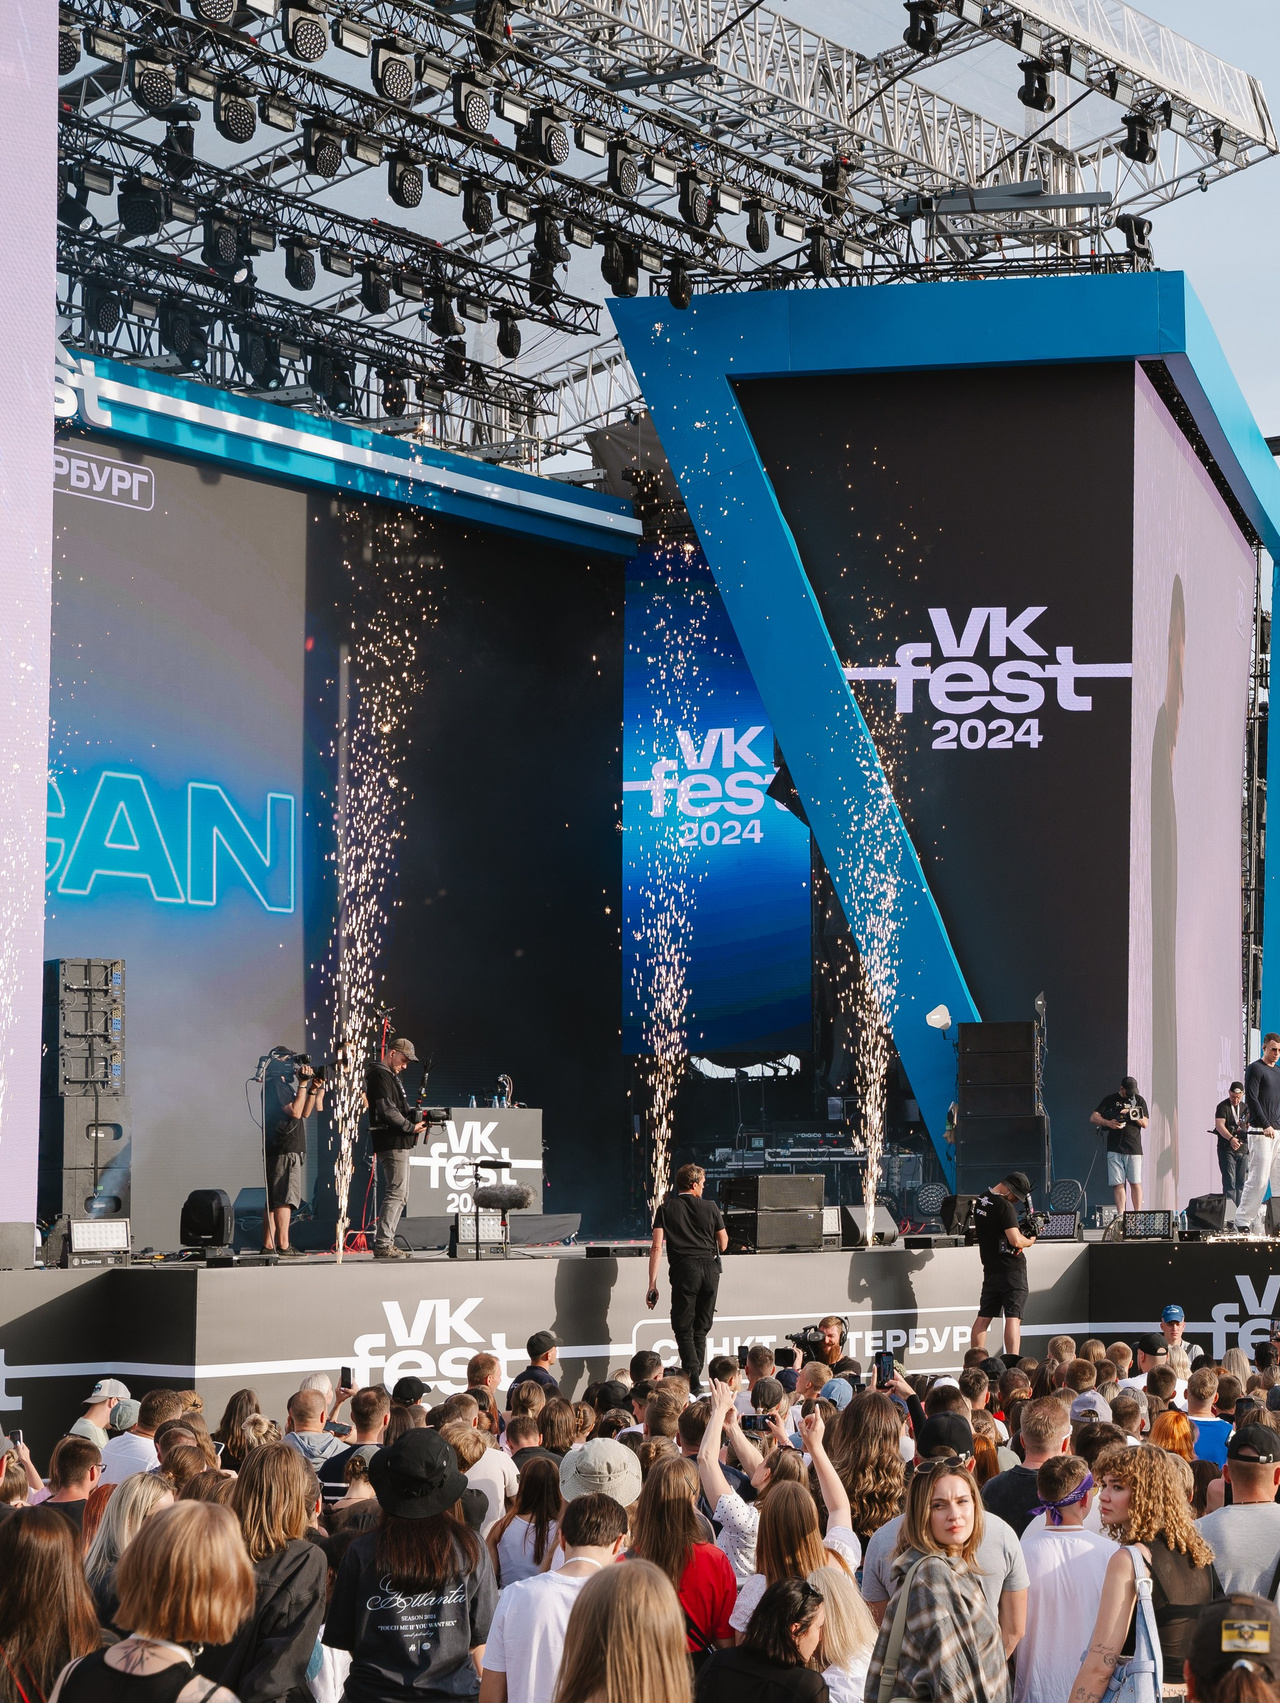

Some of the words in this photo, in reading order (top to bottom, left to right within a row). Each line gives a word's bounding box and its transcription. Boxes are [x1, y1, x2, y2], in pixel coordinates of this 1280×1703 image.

[53, 454, 149, 501] РБУРГ
[928, 606, 1049, 657] VK
[895, 642, 1092, 715] fest
[675, 725, 767, 771] VK
[931, 718, 1043, 750] 2024
[680, 819, 764, 847] 2024
[445, 1120, 499, 1155] VK
[429, 1142, 518, 1191] fest
[381, 1297, 486, 1347] VK
